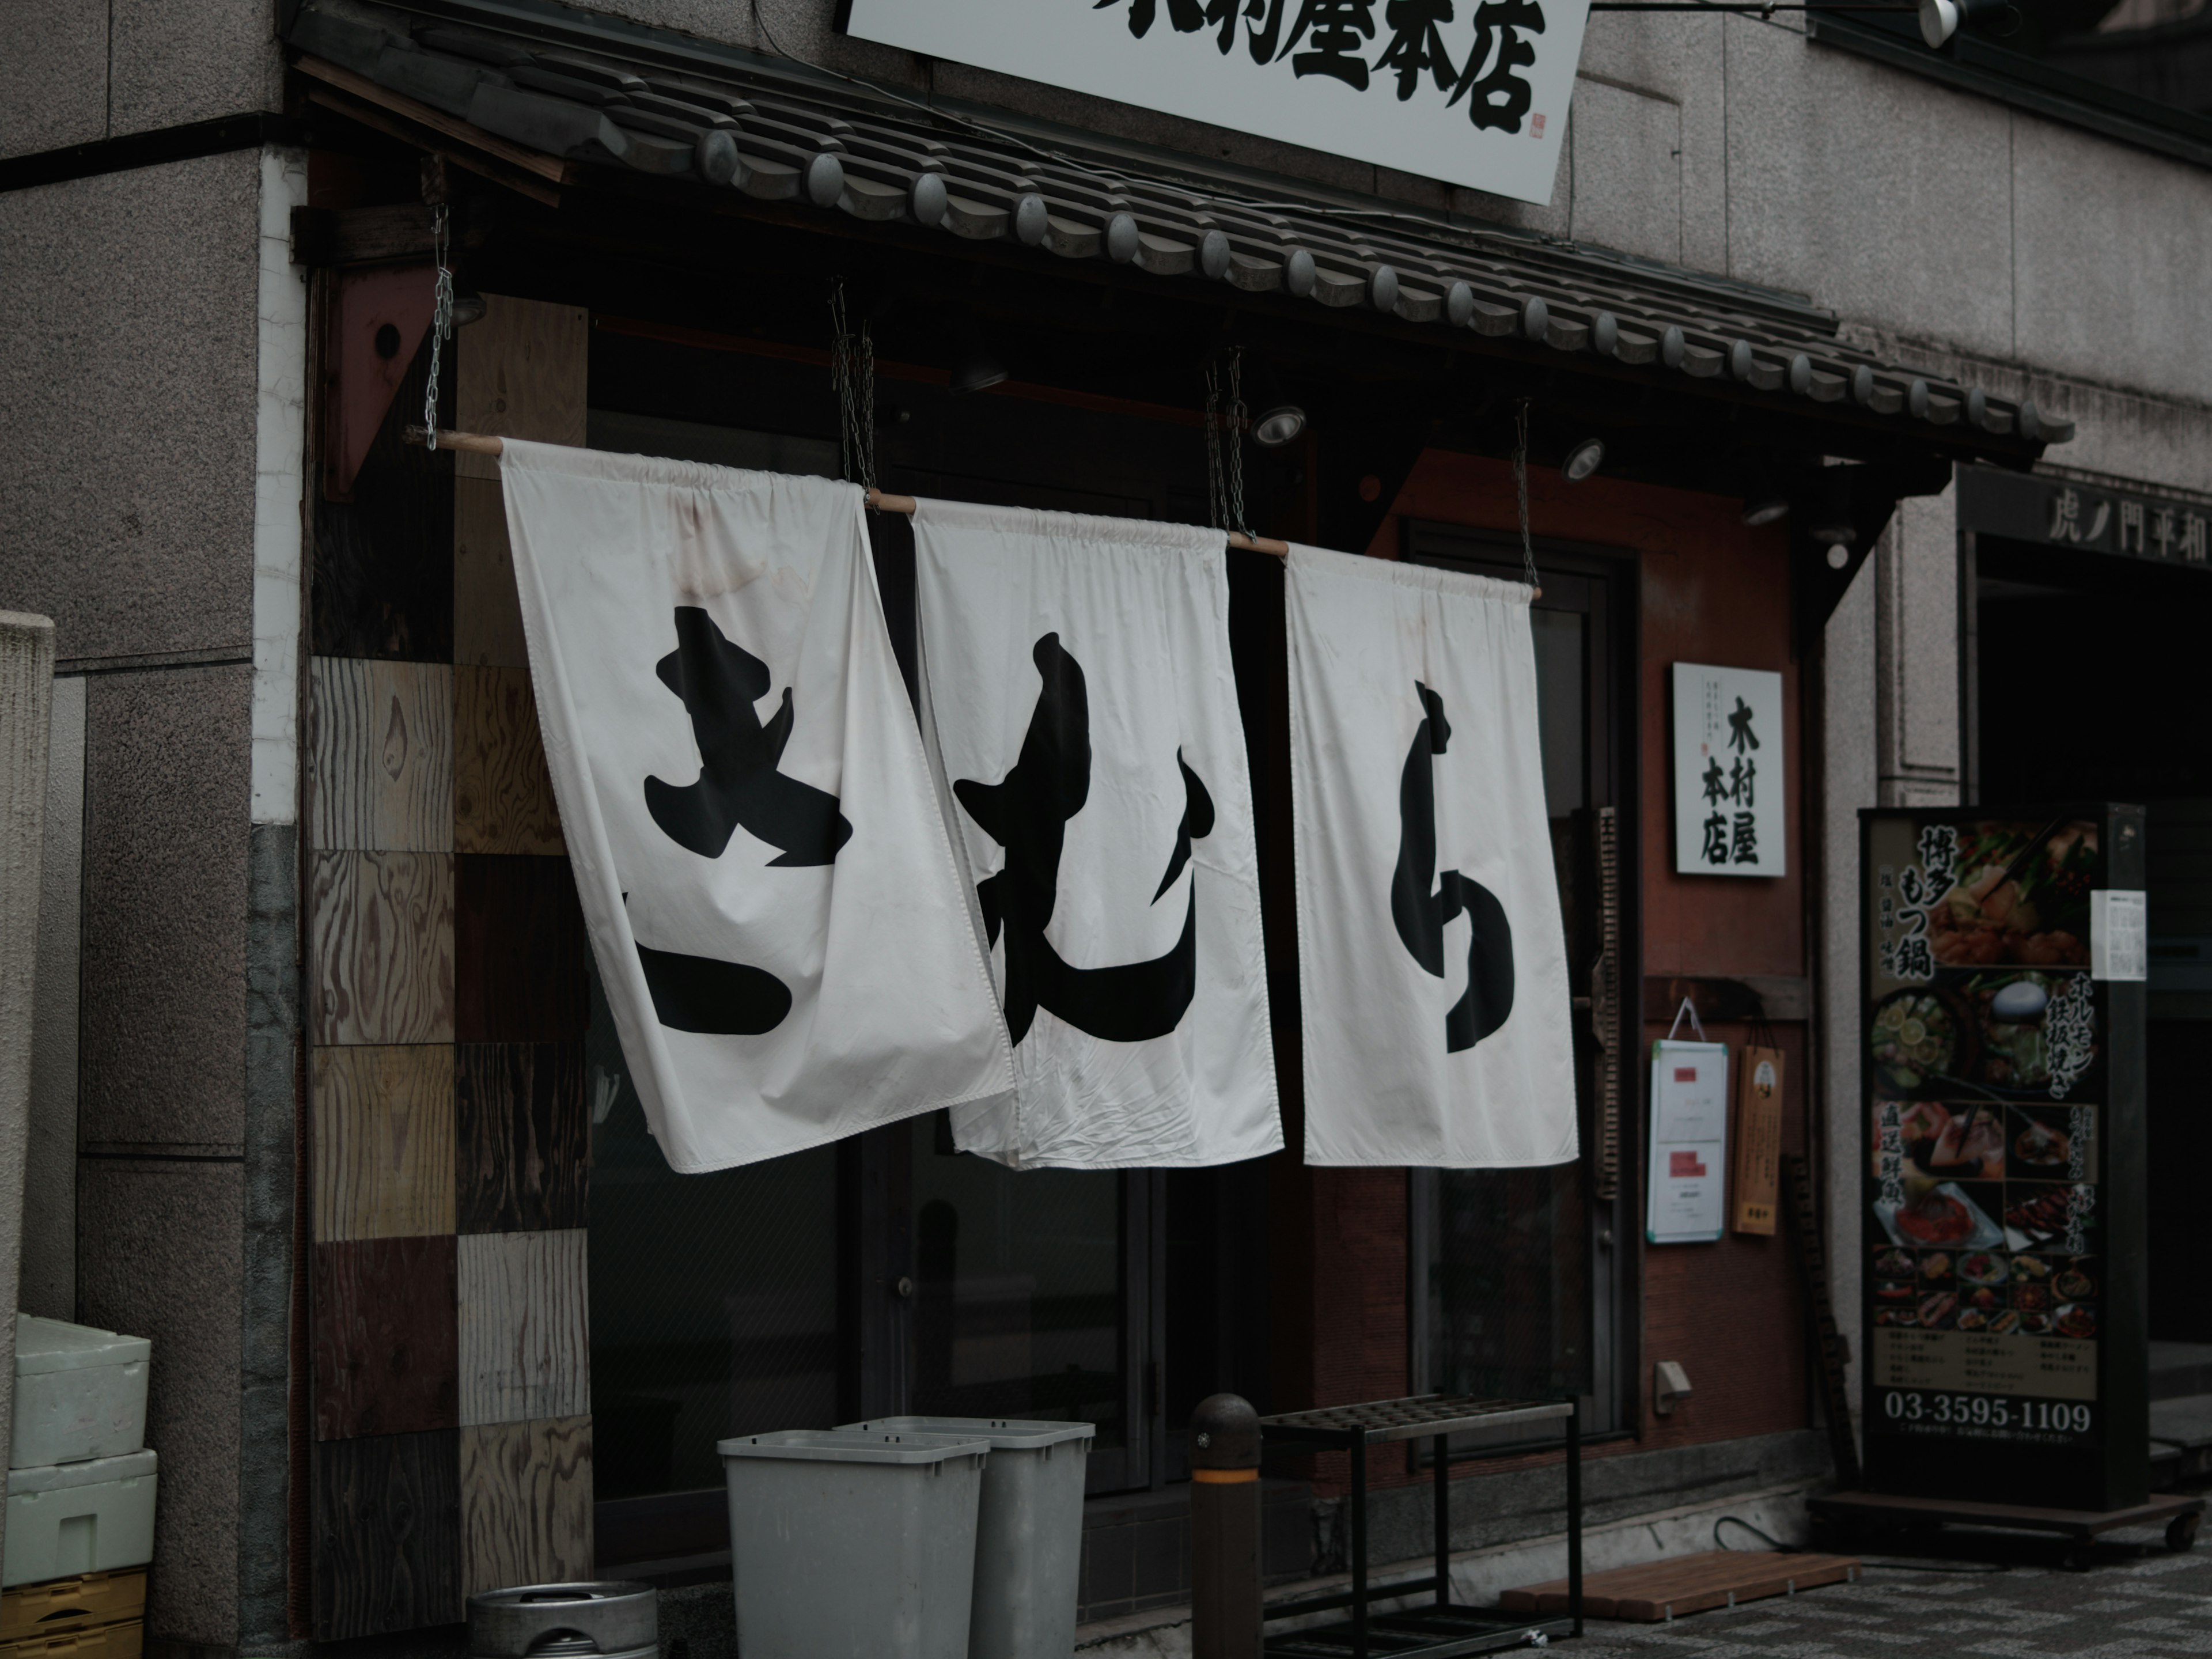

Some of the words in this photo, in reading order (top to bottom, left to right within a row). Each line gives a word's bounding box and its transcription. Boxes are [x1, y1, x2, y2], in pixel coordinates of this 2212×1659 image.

[1700, 756, 1728, 865] 本店
[1728, 695, 1760, 865] 木村屋
[1918, 826, 1956, 906] 博多
[1896, 868, 1931, 977] もつ鍋
[2048, 999, 2071, 1098] 鉄板焼き
[2069, 974, 2094, 1073] ホルモン
[1885, 1391, 2092, 1433] 03-3595-1109
